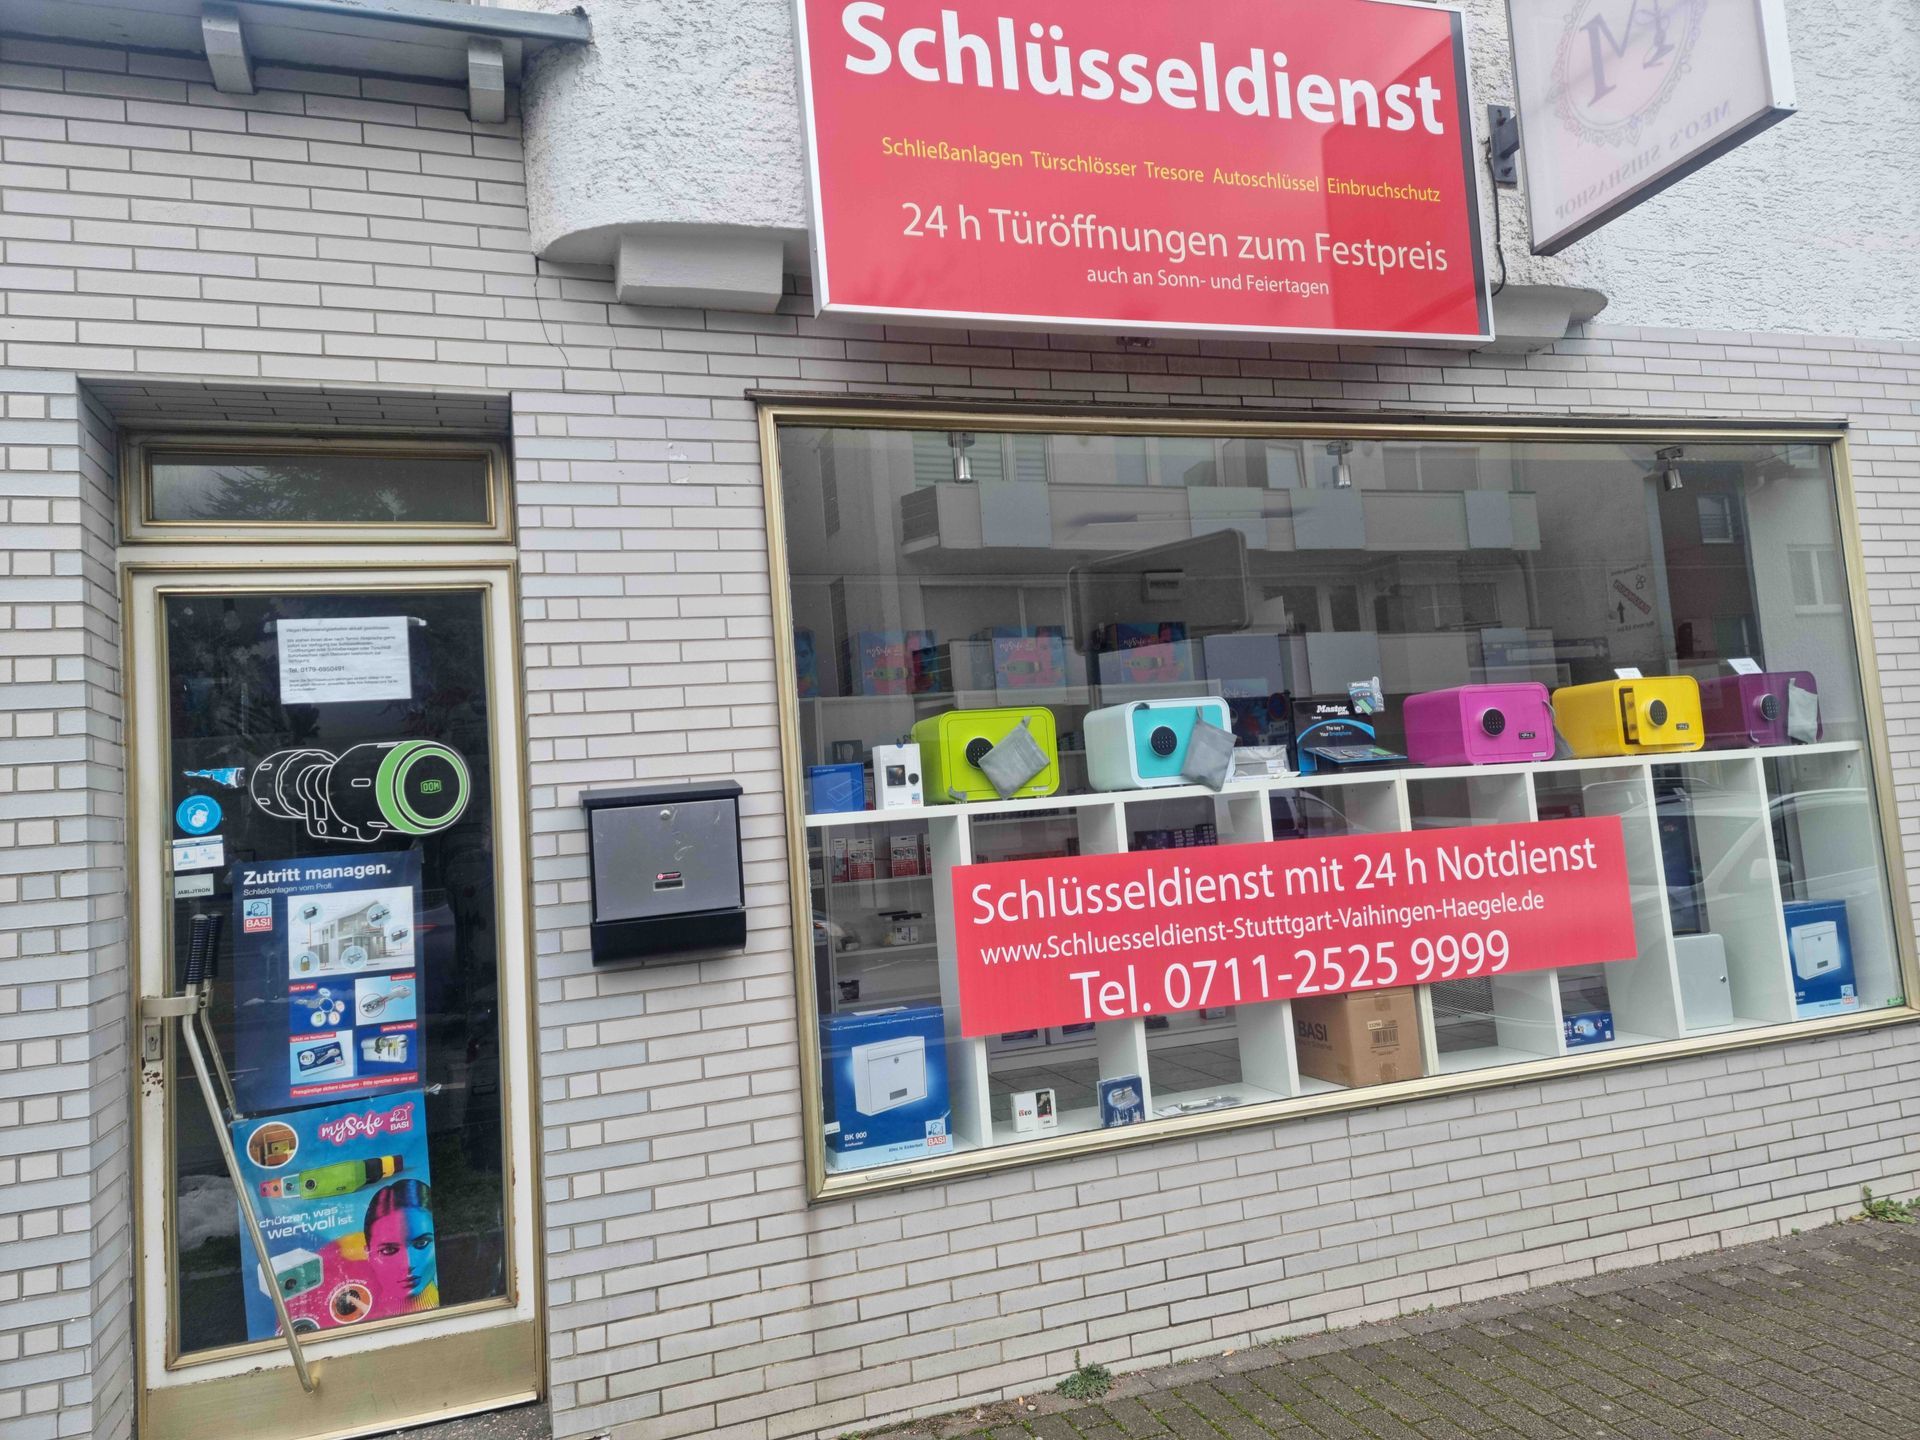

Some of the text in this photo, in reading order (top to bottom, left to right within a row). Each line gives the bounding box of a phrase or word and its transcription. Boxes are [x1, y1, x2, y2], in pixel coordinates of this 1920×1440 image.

[842, 1, 1444, 135] Schlüsseldienst
[882, 137, 1441, 202] Schließanlagen Türschlösser Tresore Autoschlüssel Einbruchschutz
[902, 203, 1448, 275] 24 h Türöffnungen zum Festpreis
[1087, 266, 1329, 298] auch an Sonn- und Feiertagen
[1316, 704, 1347, 714] Master
[243, 863, 392, 886] Zutritt managen.
[972, 838, 1598, 925] Schlüsseldienst mit 24 h Notdienst
[243, 885, 298, 896] Schließanlagen
[246, 918, 271, 928] BASI
[981, 890, 1545, 965] www.Schluesseldienst-Stutttgart-Vaihingen-Haegele.de
[1069, 930, 1510, 1019] Tel. 0711-2525 9999
[1298, 1020, 1328, 1042] BASI
[321, 1113, 384, 1142] mySafe
[390, 1120, 410, 1131] BASI
[928, 1136, 946, 1146] BASI
[258, 1206, 338, 1228] chützen, was
[267, 1217, 335, 1240] wertvoll
